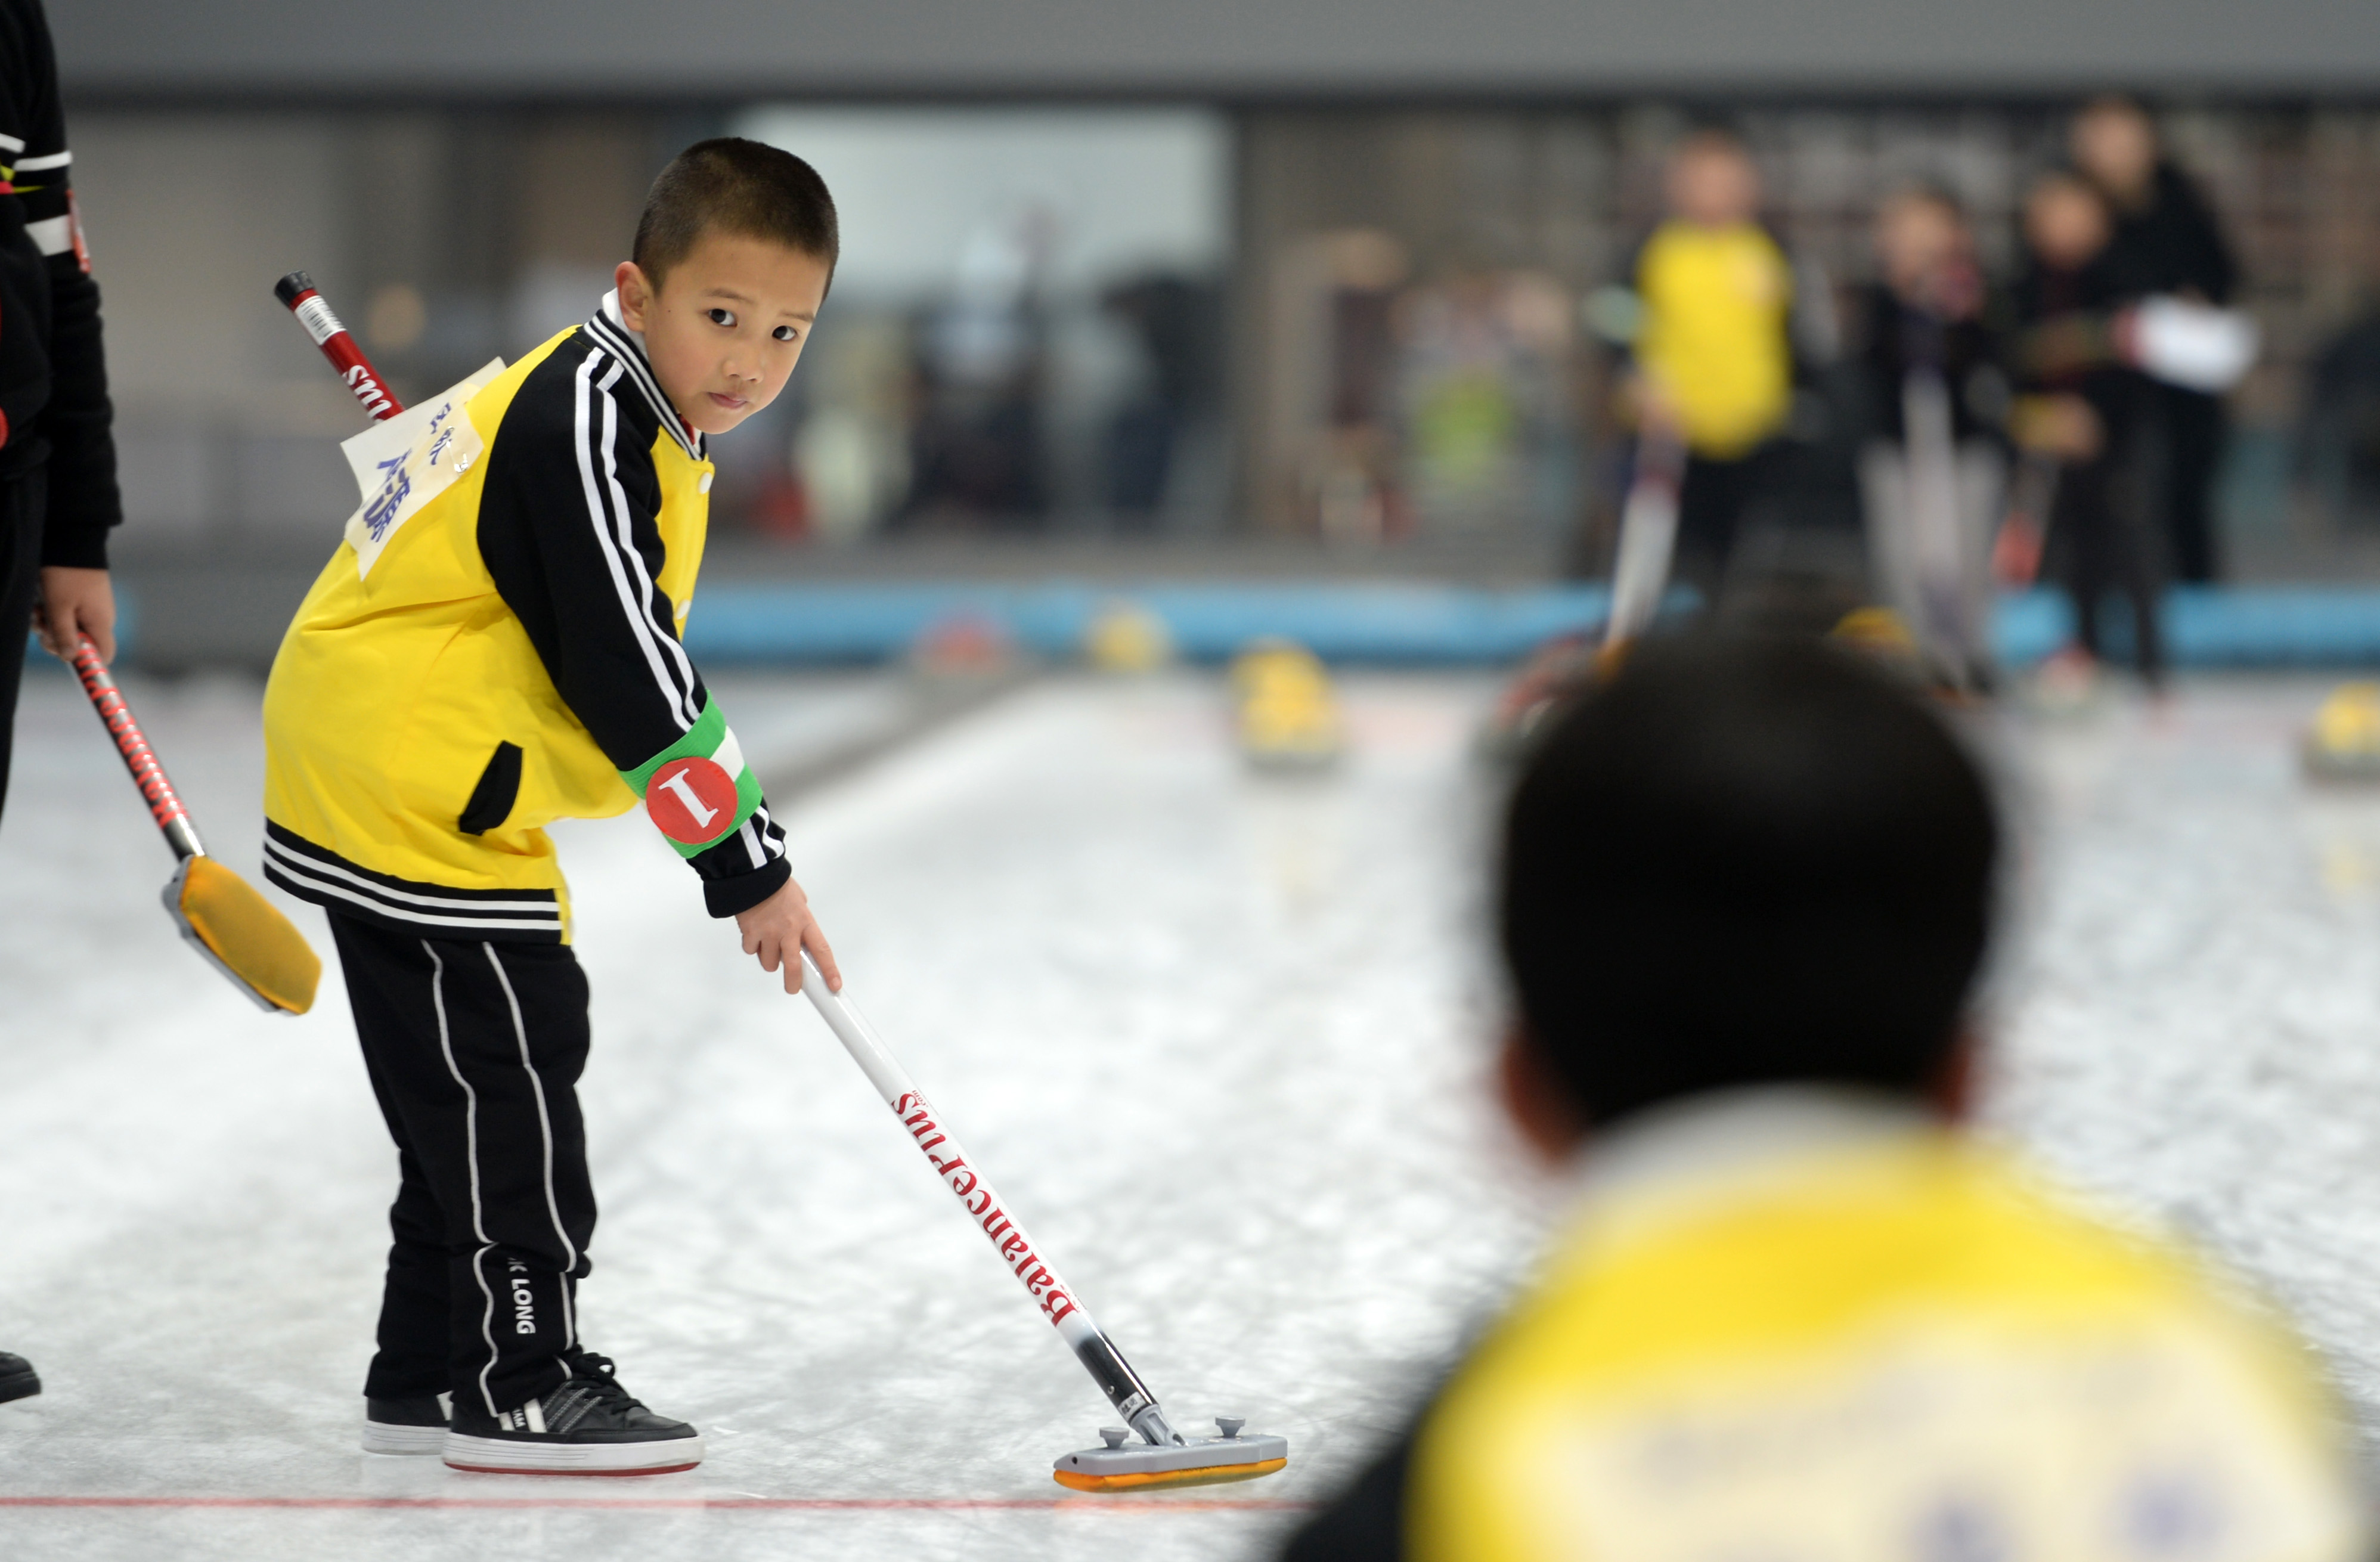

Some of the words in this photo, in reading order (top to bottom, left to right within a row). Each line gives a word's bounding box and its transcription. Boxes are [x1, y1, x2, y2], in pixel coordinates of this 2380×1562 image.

[343, 364, 392, 424] lus
[891, 1092, 1080, 1327] BalancePlus
[511, 1278, 536, 1334] LONG
